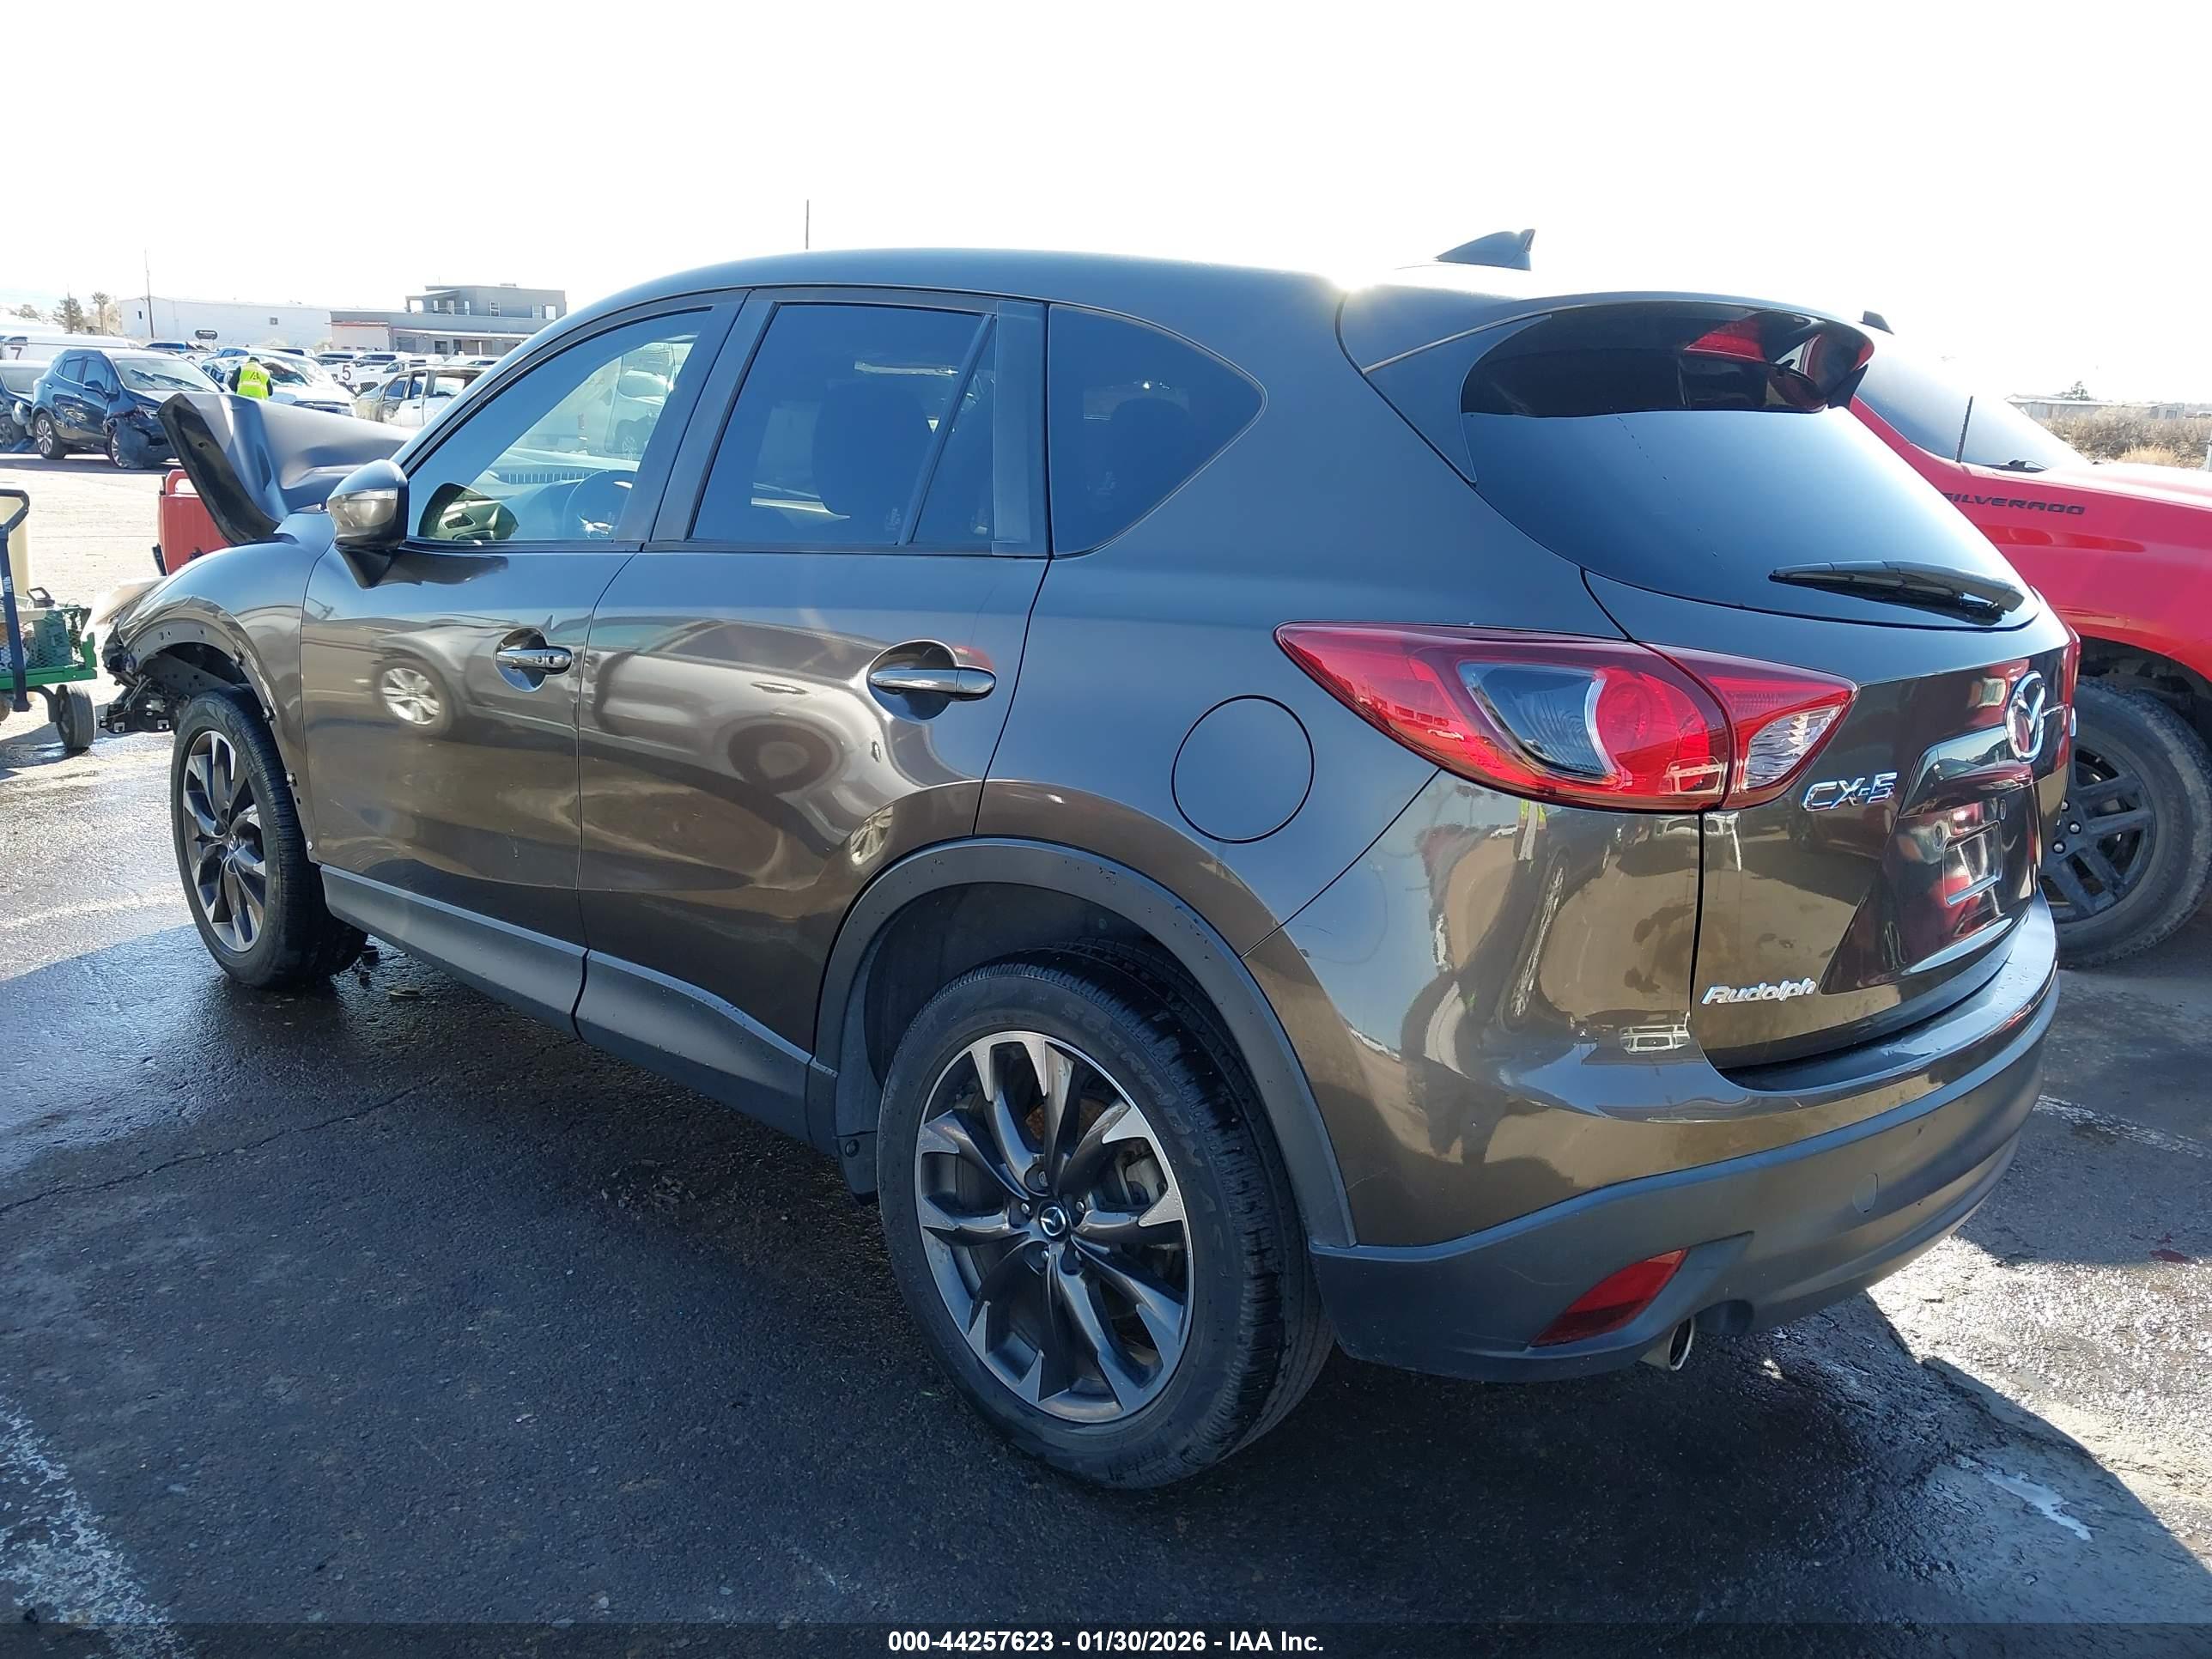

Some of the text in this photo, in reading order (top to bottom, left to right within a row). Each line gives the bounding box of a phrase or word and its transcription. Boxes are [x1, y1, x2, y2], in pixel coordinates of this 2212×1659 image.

[10, 346, 22, 360] 7
[342, 364, 352, 381] 5
[1802, 771, 1898, 811] CX-5
[1700, 977, 1817, 1005] Rudolph
